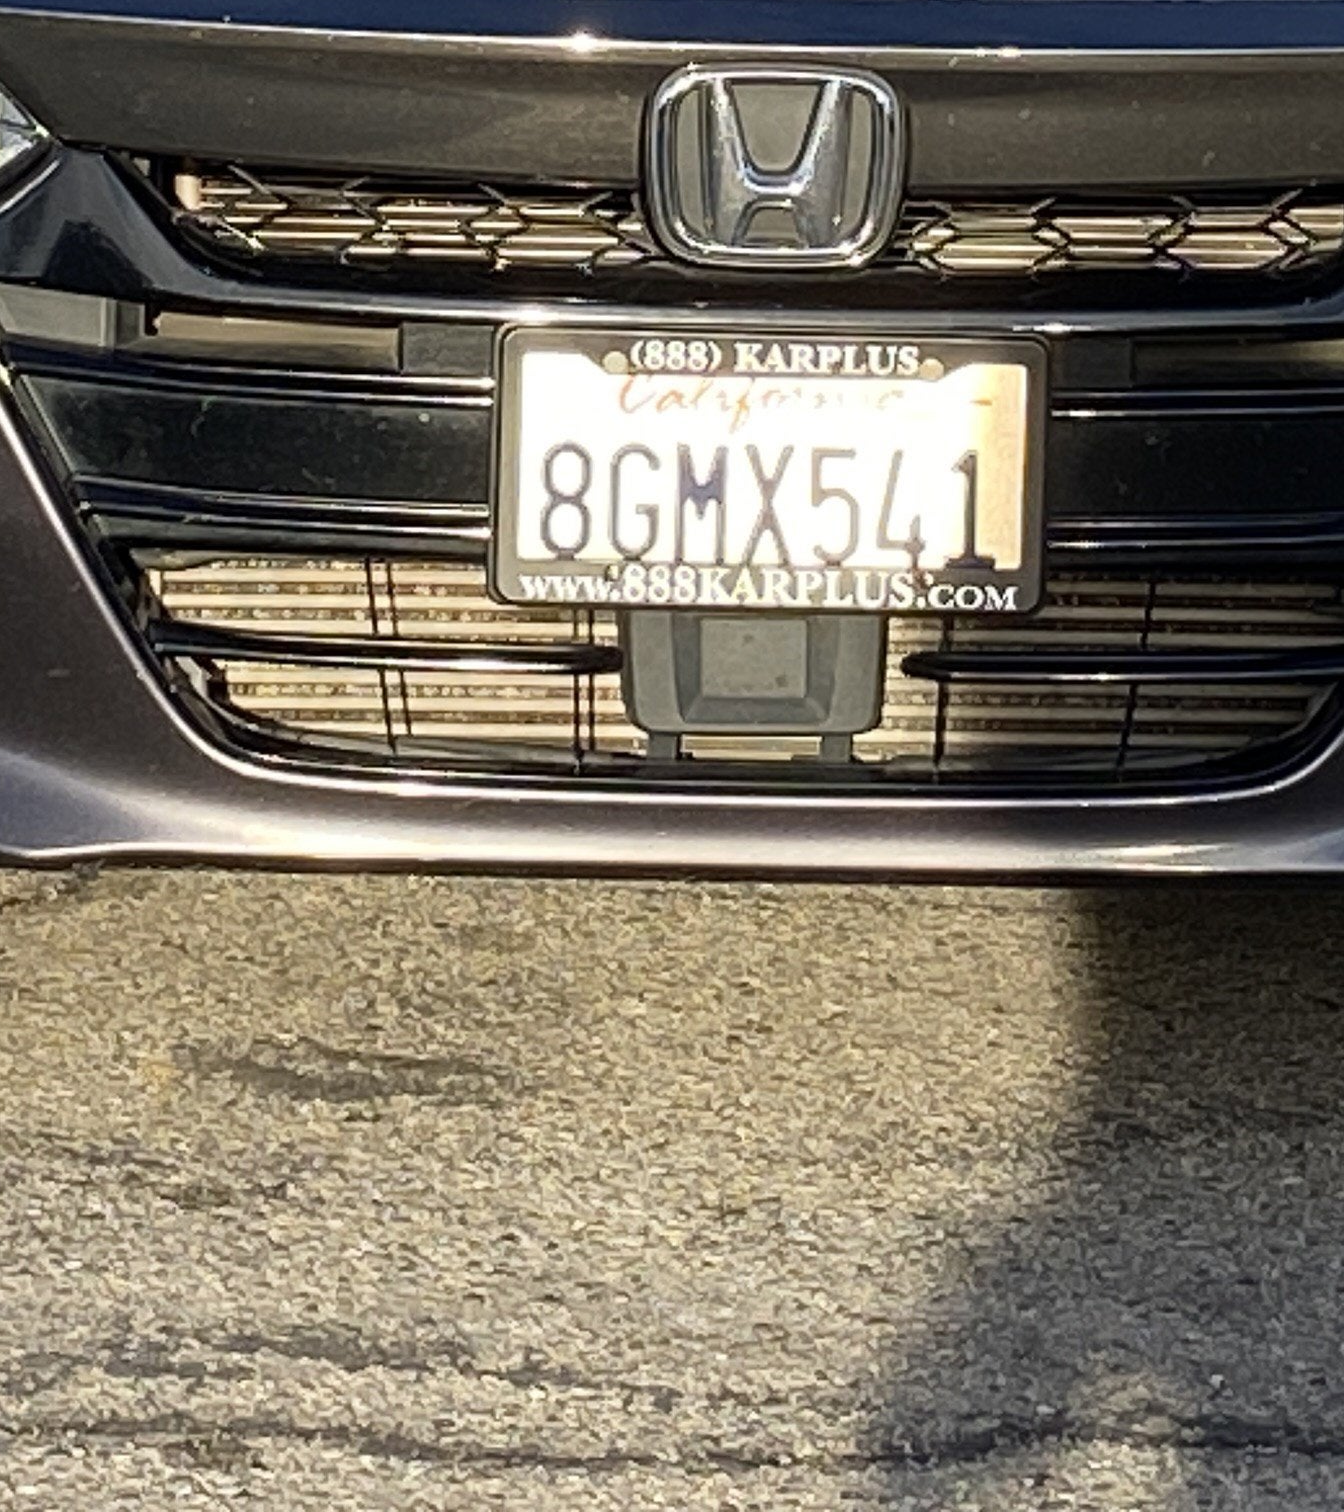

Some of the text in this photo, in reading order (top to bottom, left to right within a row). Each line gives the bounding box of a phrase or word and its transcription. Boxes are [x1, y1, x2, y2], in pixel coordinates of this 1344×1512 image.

[629, 339, 920, 376] (888) KARPLUS
[540, 440, 996, 573] 8GMX541
